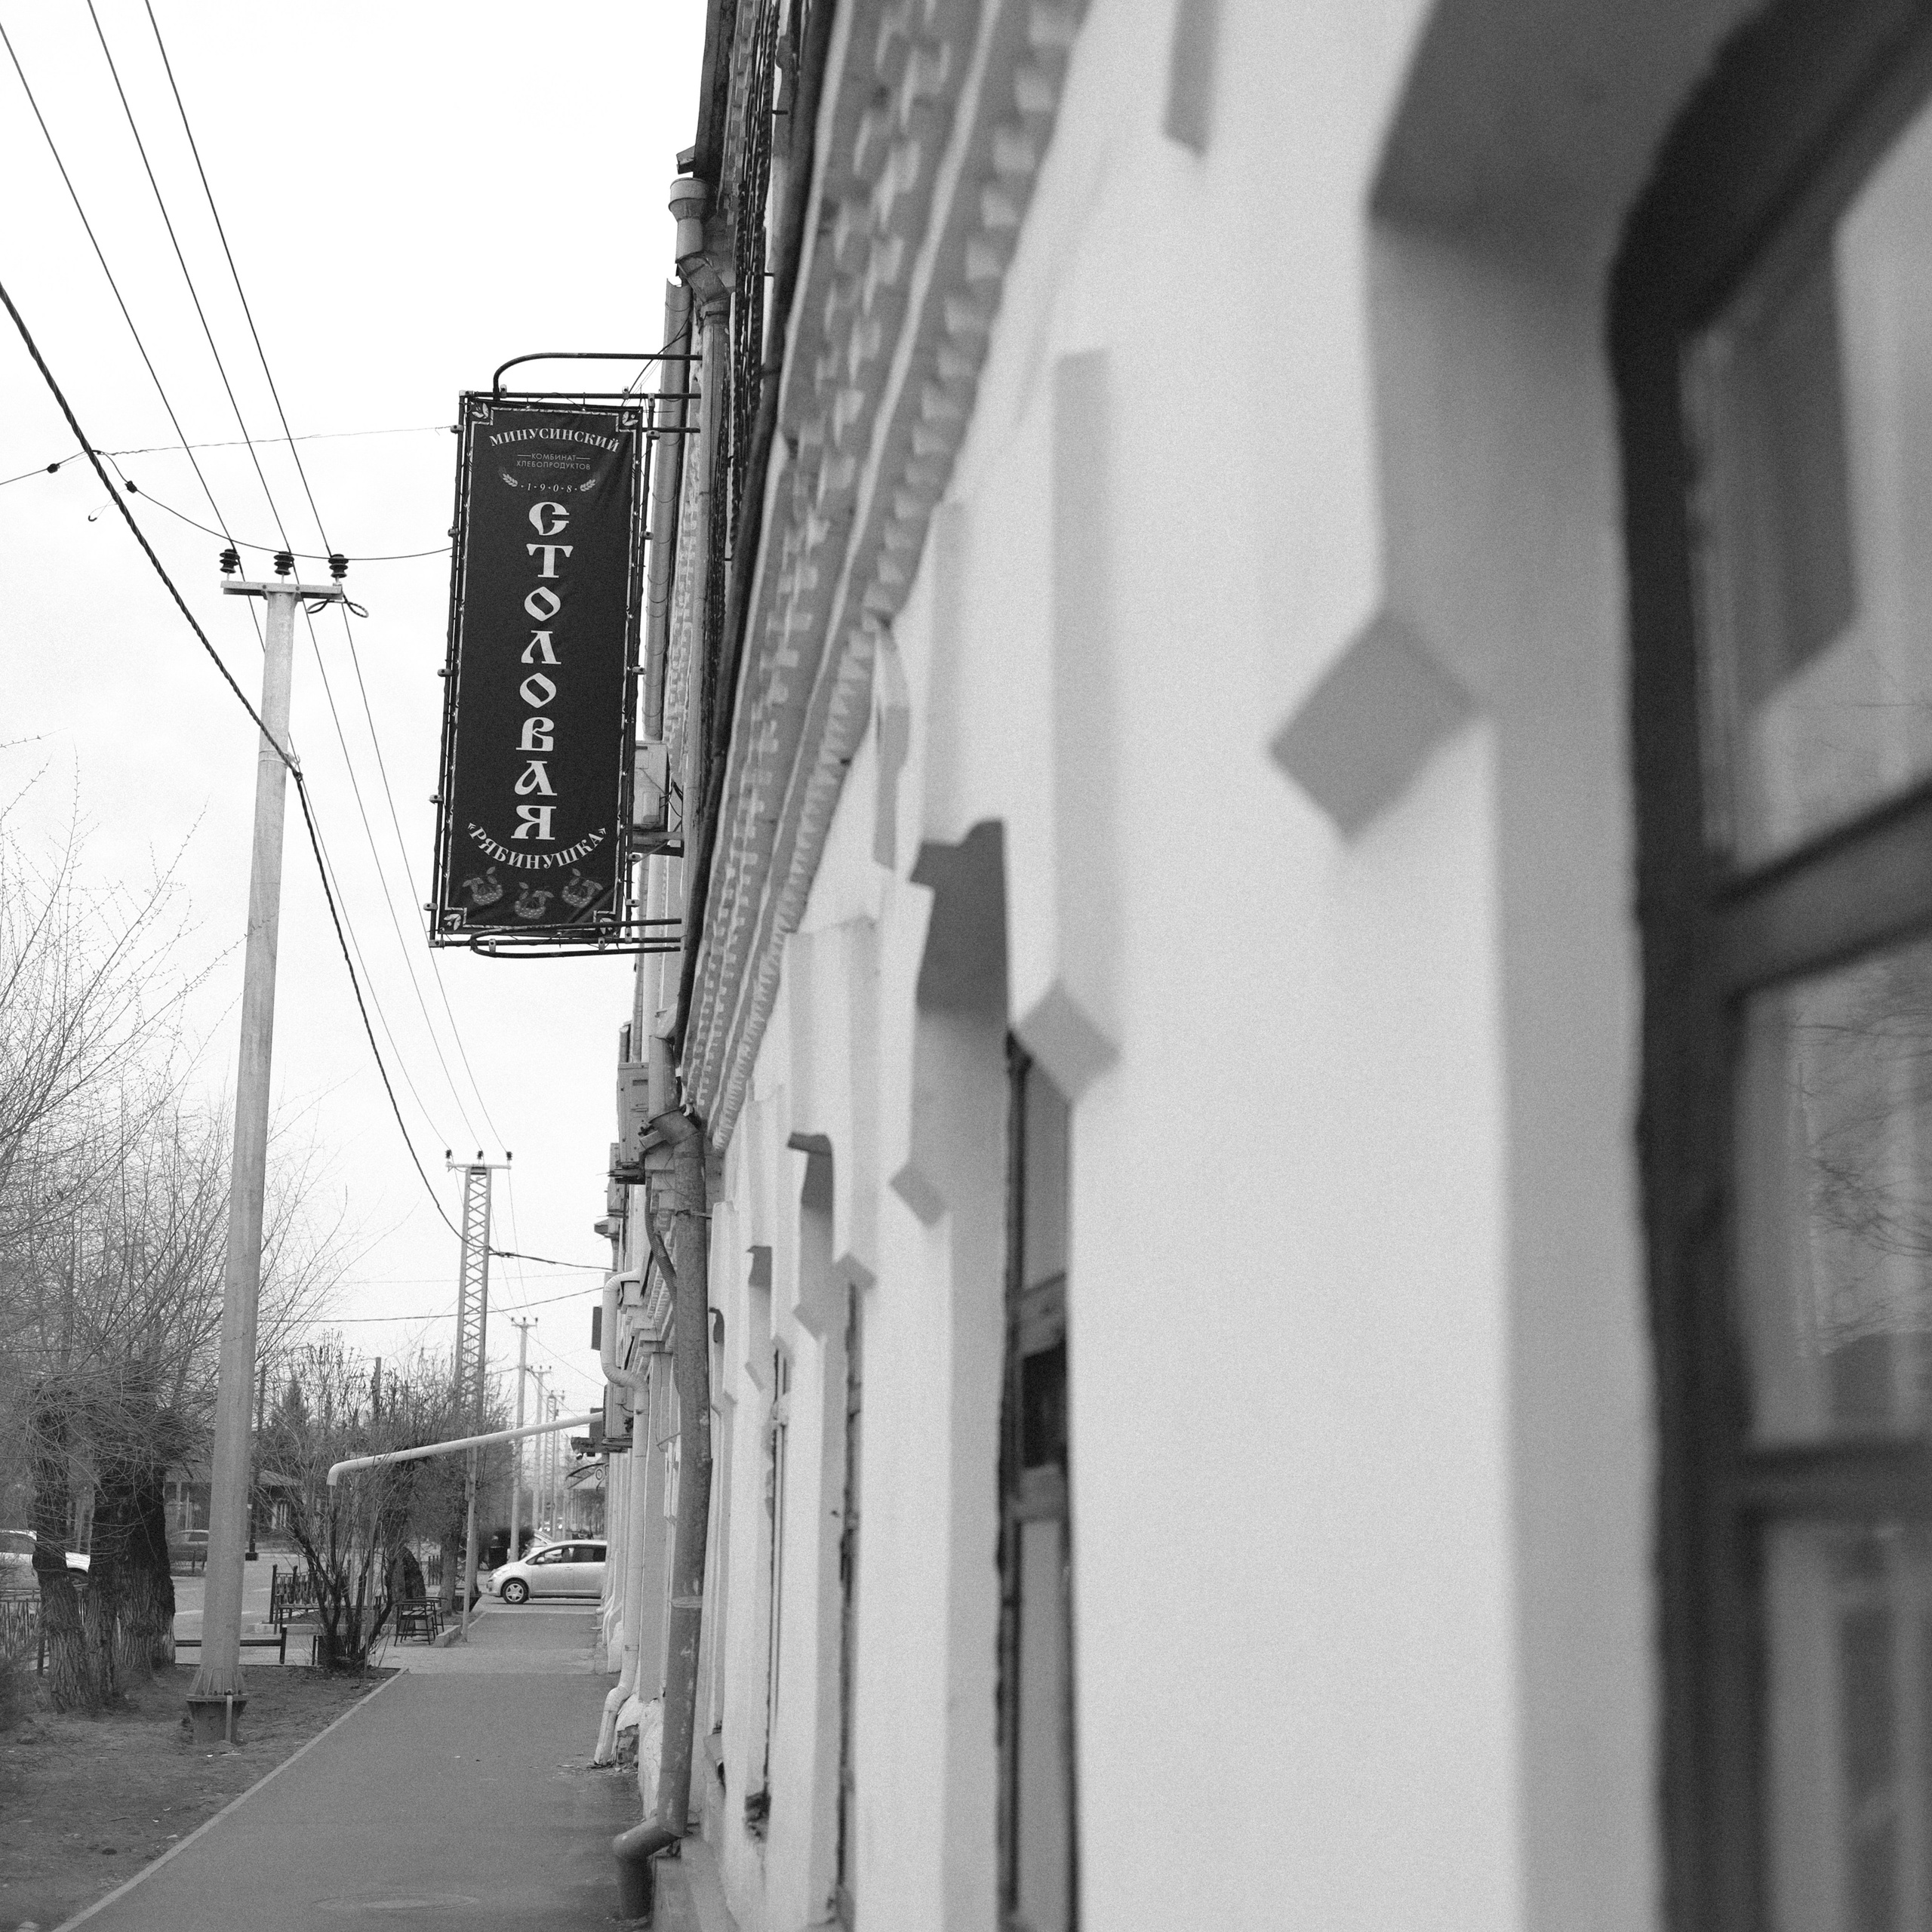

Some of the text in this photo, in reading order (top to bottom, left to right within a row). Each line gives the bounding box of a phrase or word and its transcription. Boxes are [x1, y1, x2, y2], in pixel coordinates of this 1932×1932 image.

[489, 428, 620, 453] МИНУСИНСКИЙ
[516, 460, 590, 470] ХЛЕБОПРОДУКТОВ
[531, 453, 576, 461] КОМБИНАТ
[511, 501, 574, 840] СТОЛОВАЯ
[468, 822, 607, 869] «РЯБИНУШКА»
